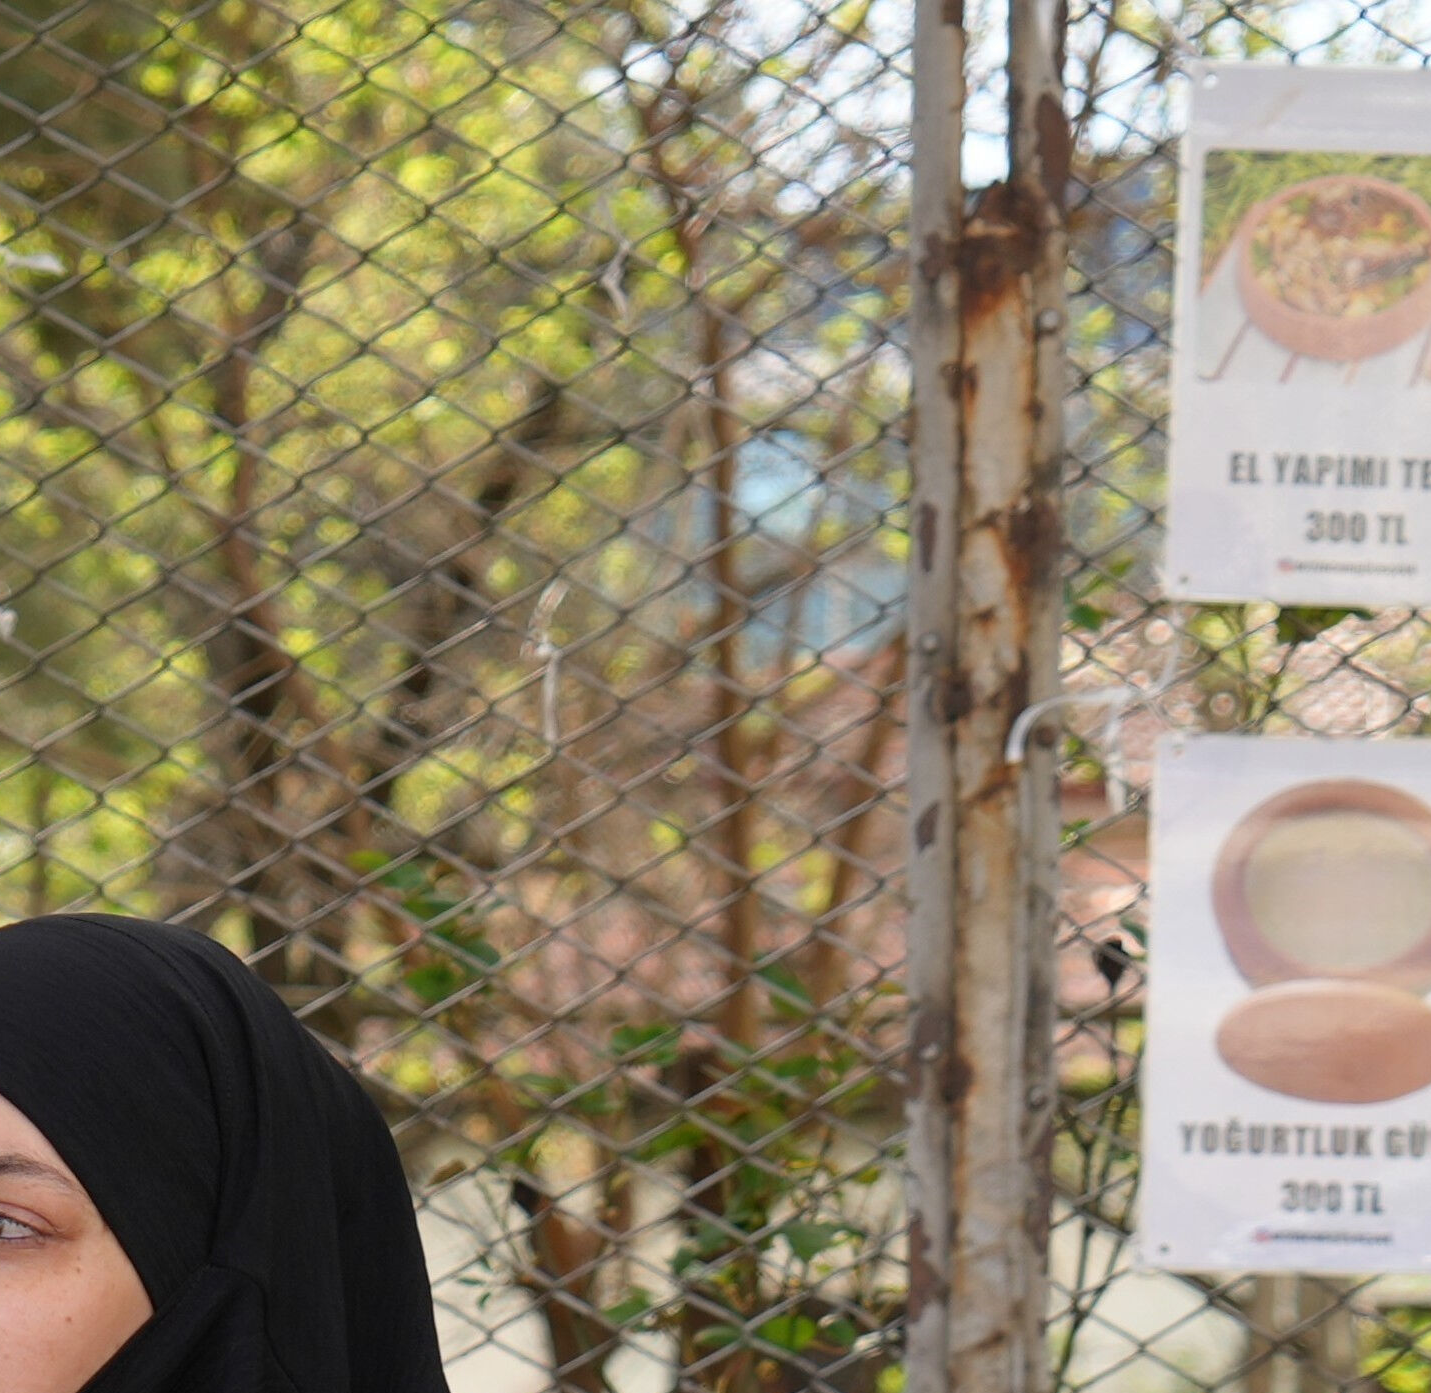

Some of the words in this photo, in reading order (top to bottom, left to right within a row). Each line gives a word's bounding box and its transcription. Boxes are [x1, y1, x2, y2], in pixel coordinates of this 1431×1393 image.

[1229, 452, 1261, 485] EL
[1306, 510, 1368, 543] 300
[1377, 514, 1408, 546] TL
[1180, 1117, 1373, 1158] YOĞURTLUK
[1281, 1179, 1343, 1214] 300
[1351, 1181, 1384, 1214] TL
